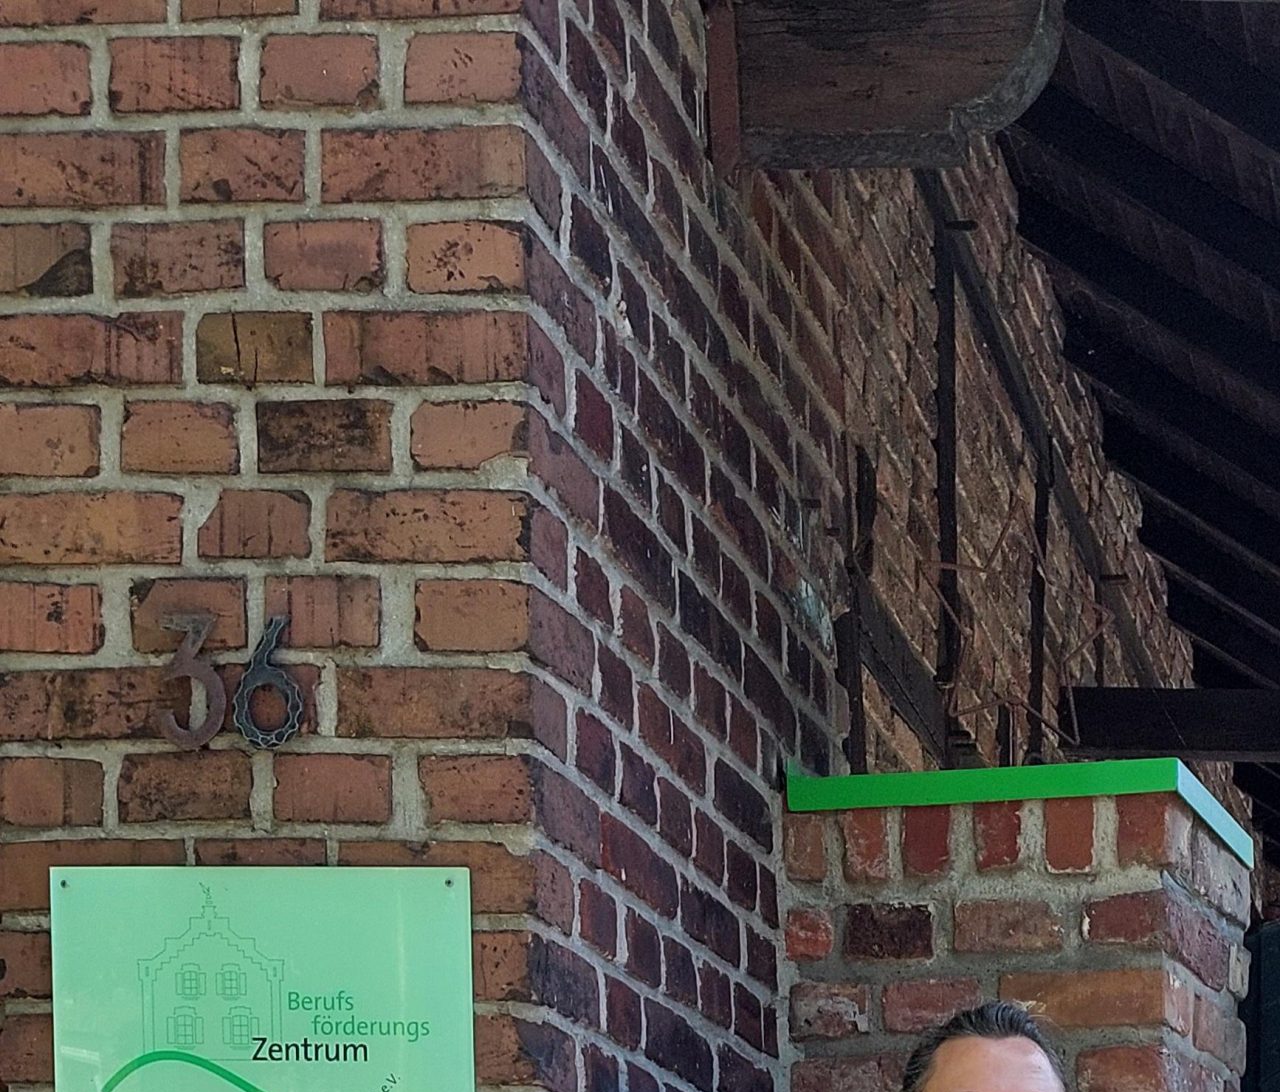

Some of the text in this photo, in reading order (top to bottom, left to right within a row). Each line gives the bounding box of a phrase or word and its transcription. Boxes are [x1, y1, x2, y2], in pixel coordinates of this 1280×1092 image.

[158, 609, 304, 750] 36
[287, 990, 354, 1011] Berufs
[311, 1015, 430, 1042] förderungs
[251, 1037, 368, 1062] Zentrum
